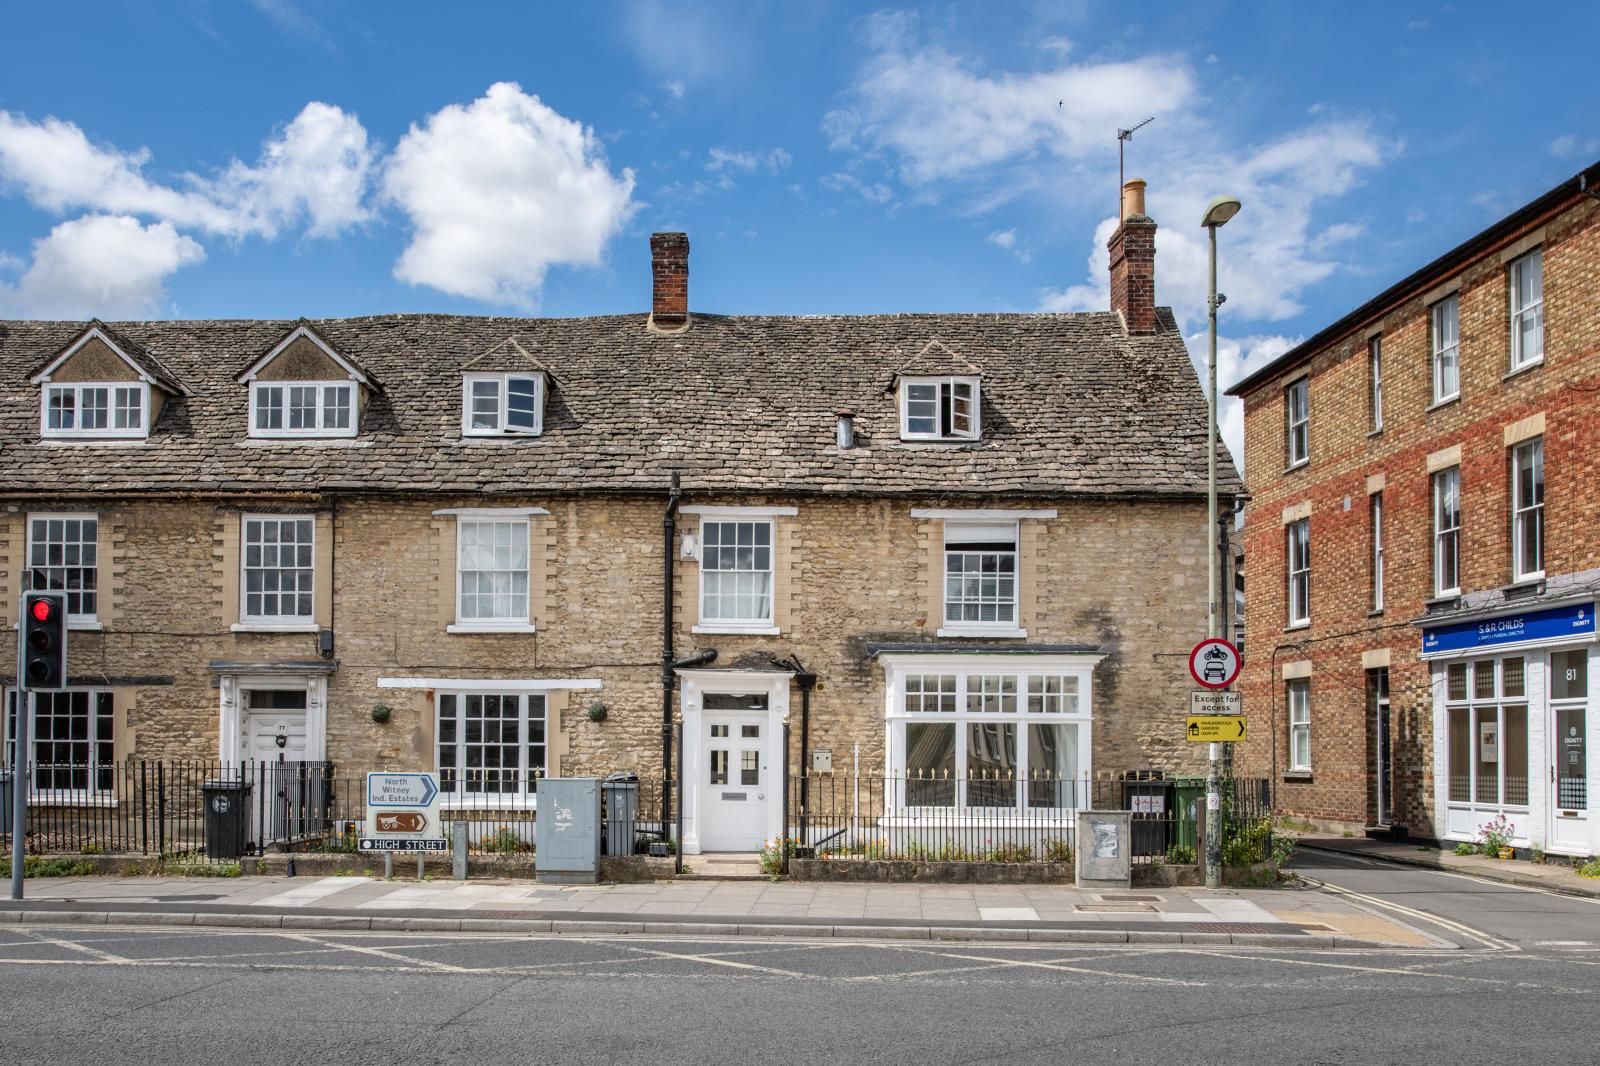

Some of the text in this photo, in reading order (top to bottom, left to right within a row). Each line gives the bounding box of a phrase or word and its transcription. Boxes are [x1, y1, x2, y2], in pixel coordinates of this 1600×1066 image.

[1497, 619, 1524, 631] CHILDS
[1566, 668, 1576, 681] 81
[1194, 695, 1238, 703] Except for
[382, 786, 410, 794] Witney
[410, 818, 415, 827] 1
[374, 840, 445, 850] HIGH STREET
